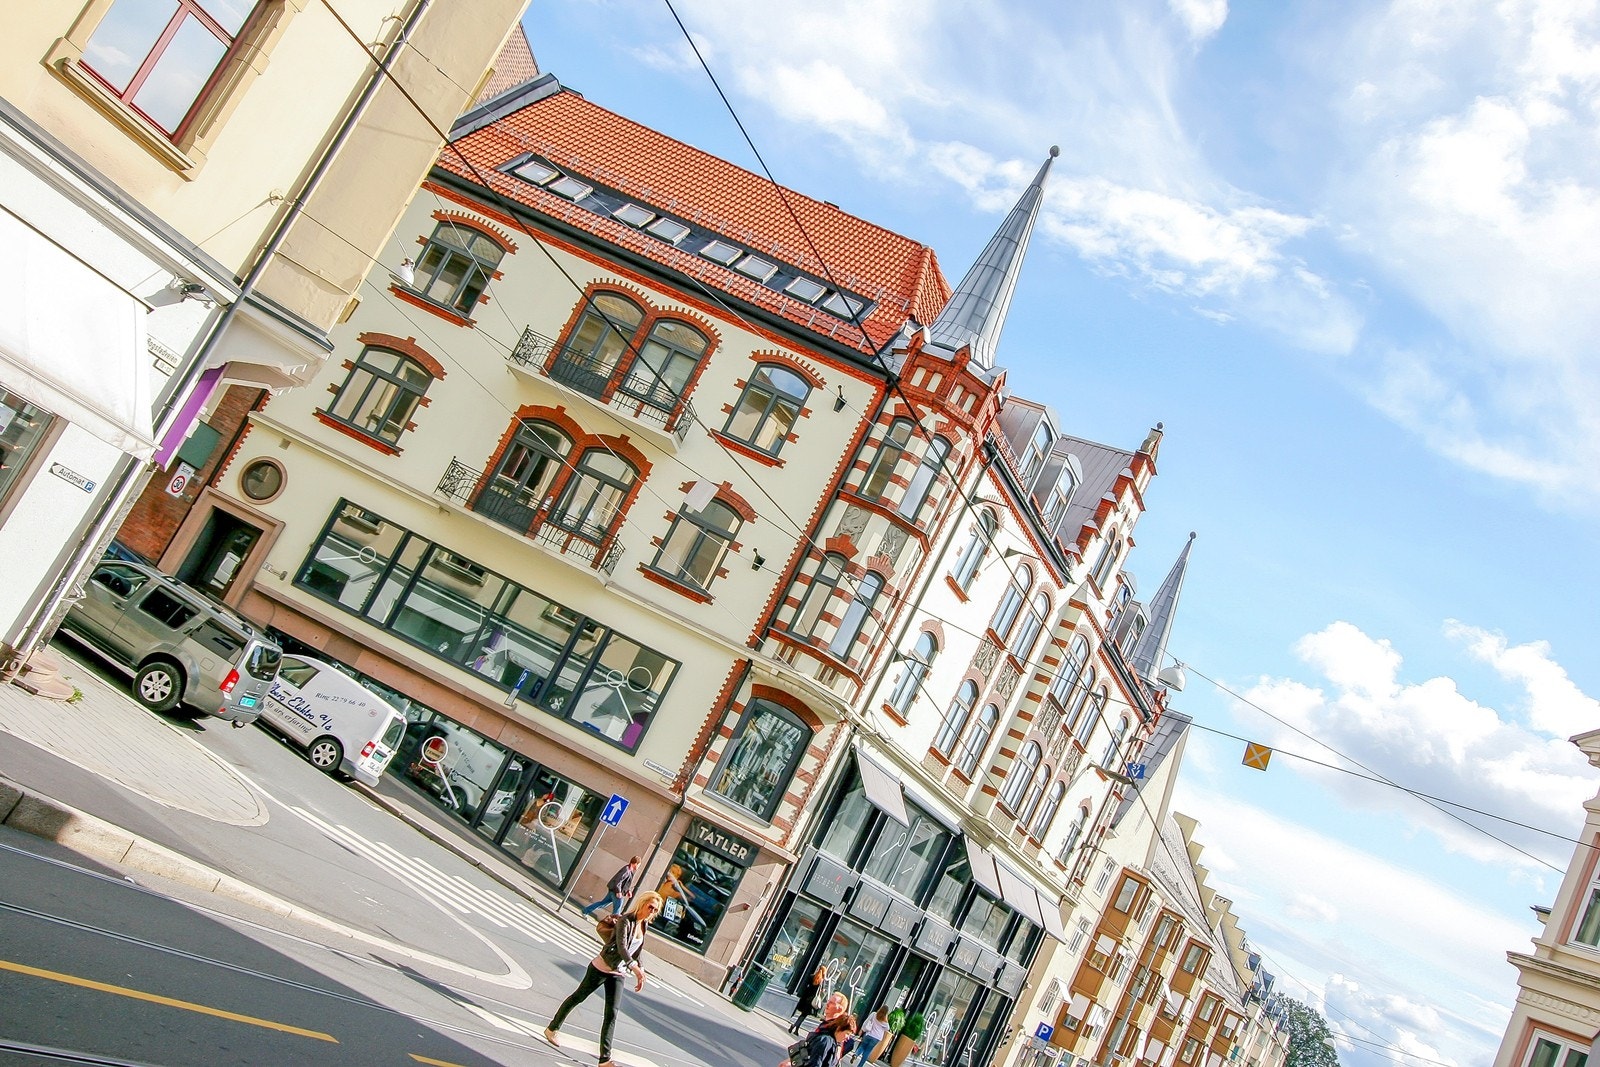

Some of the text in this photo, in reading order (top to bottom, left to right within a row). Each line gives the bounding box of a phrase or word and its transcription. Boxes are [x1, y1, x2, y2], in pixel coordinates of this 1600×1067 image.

[58, 468, 85, 486] Automat
[315, 692, 329, 702] Ring
[288, 696, 315, 720] Elektro
[698, 825, 748, 861] TATLER
[1038, 1024, 1049, 1038] P
